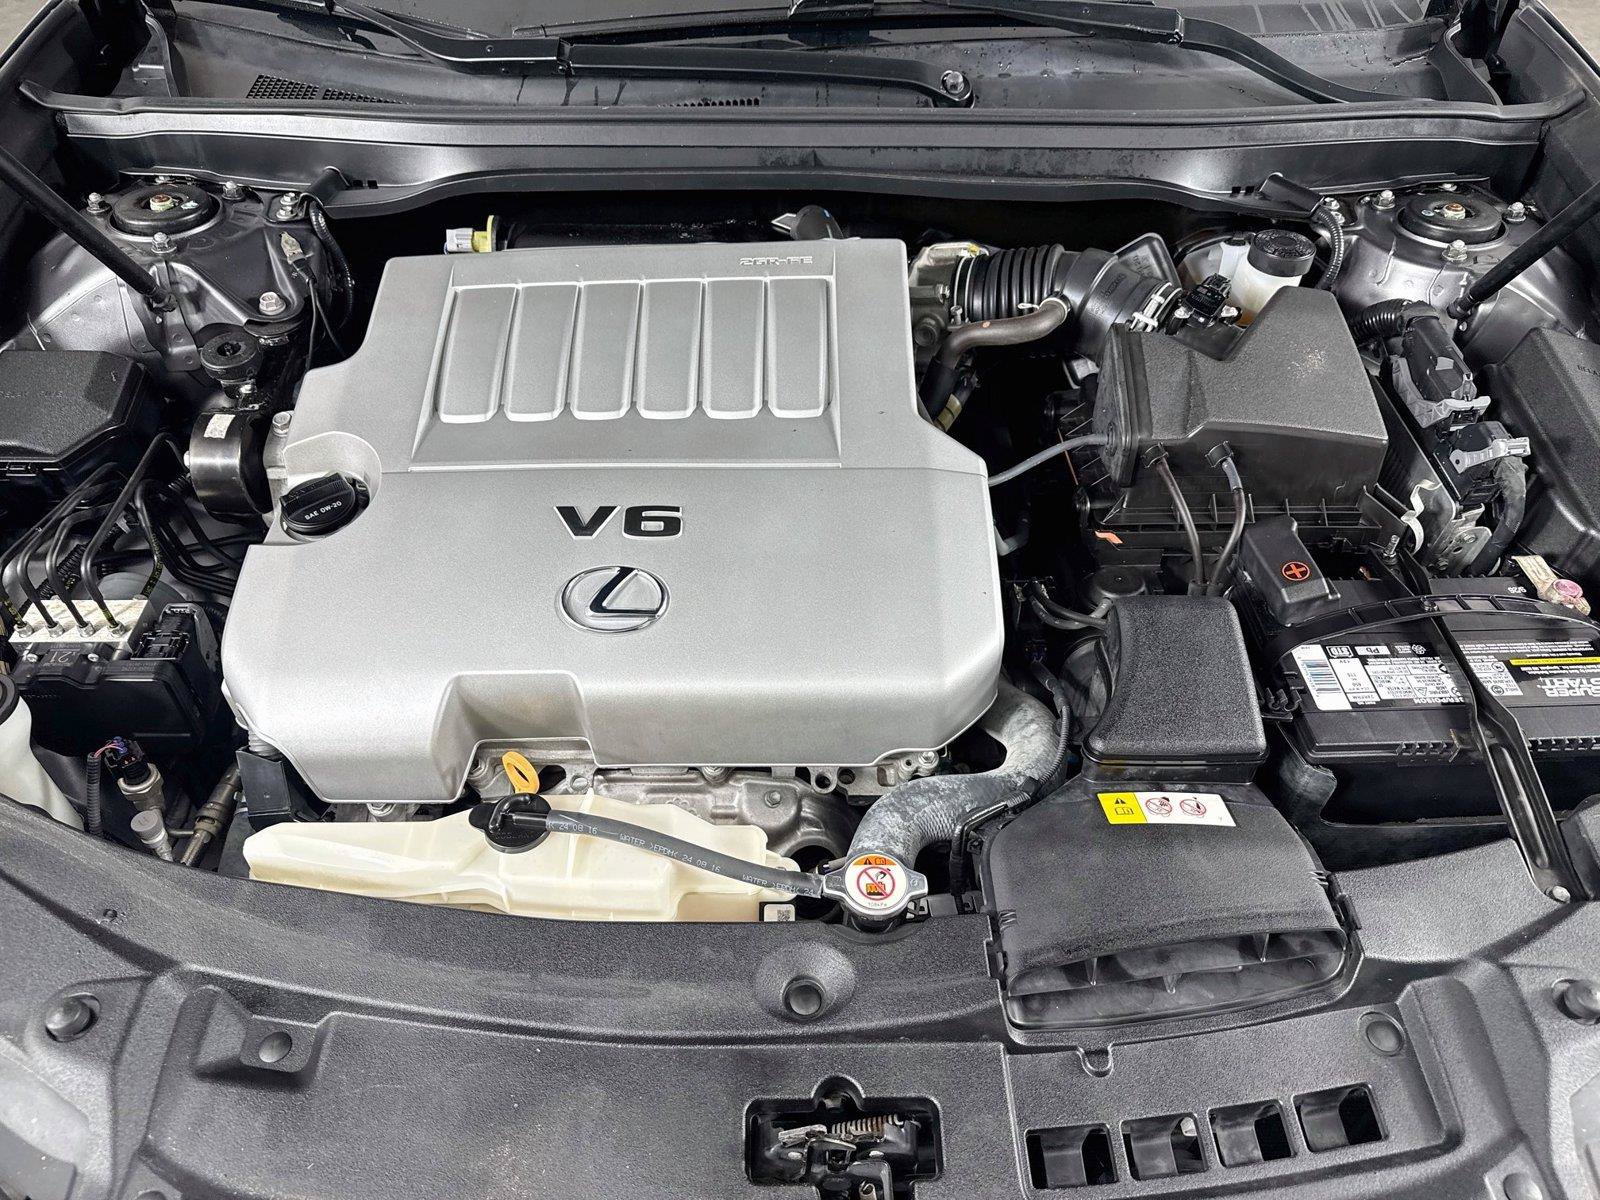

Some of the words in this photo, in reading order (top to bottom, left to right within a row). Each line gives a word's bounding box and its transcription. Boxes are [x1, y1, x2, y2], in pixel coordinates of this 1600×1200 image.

[739, 256, 813, 266] 2GR-FE
[304, 510, 319, 520] SAE
[320, 500, 342, 513] 0W-20
[553, 505, 683, 539] V6
[1544, 687, 1600, 698] SUPER
[619, 833, 645, 847] WATER
